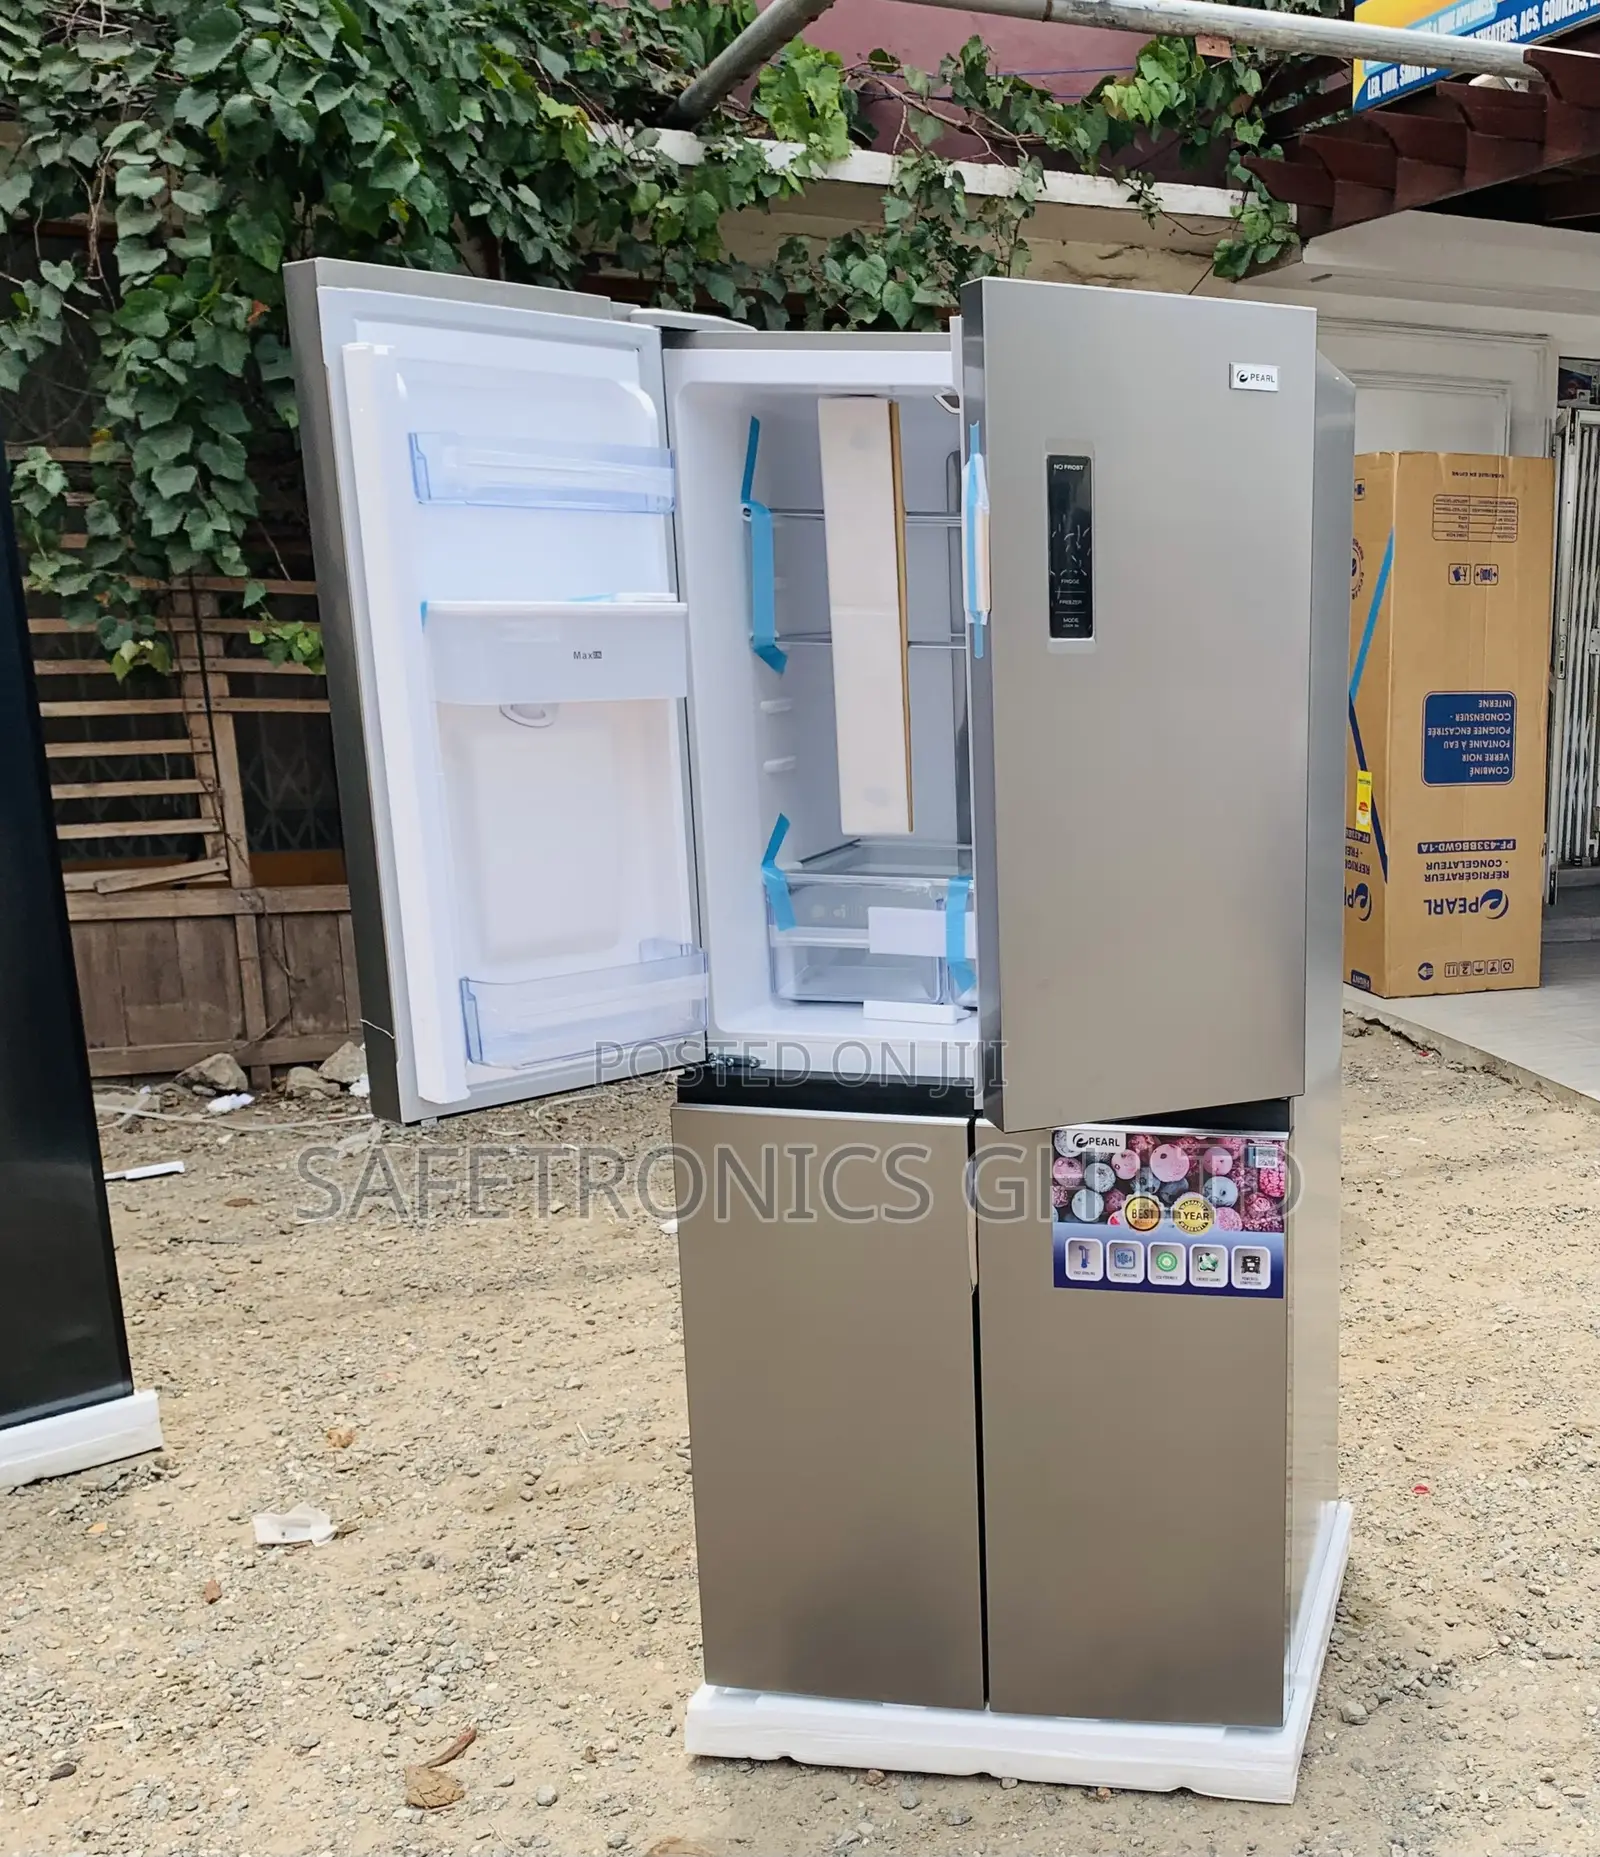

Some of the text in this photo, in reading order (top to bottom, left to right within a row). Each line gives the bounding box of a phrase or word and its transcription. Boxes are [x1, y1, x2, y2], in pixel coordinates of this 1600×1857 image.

[1250, 373, 1275, 383] PEARL
[1478, 699, 1512, 708] INTERNE
[1443, 740, 1459, 749] EAU
[1469, 739, 1511, 749] FONTAINE
[1461, 753, 1510, 762] VERRE NOIR
[1469, 766, 1510, 777] COMBINÉ
[1425, 859, 1502, 871] CONGELATEUR
[1423, 896, 1479, 916] PEARL
[1088, 1137, 1120, 1147] PEARL
[1131, 1209, 1155, 1219] BEST
[1183, 1211, 1210, 1221] YEAR
